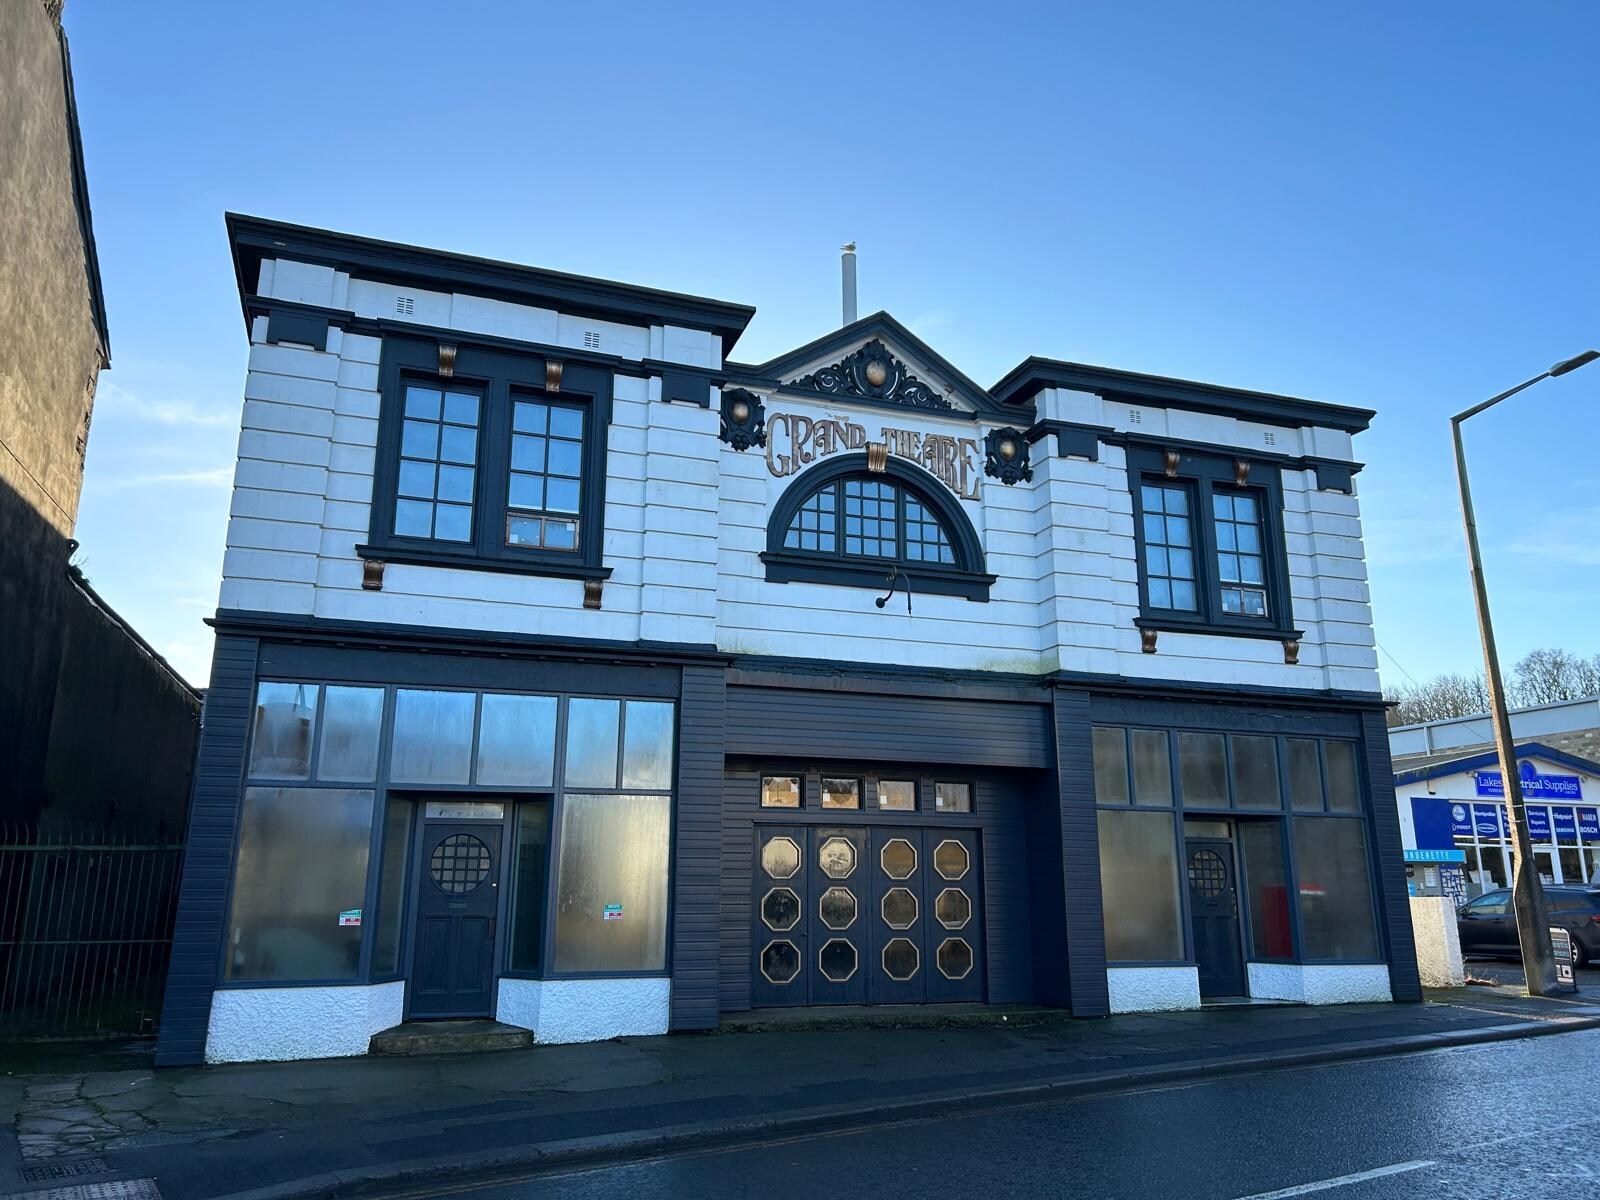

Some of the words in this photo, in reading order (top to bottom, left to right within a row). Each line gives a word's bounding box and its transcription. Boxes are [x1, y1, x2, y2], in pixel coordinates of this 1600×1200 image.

[766, 413, 867, 477] GRAND
[881, 427, 981, 500] THEATRE
[1478, 777, 1503, 788] Lakes
[1520, 779, 1543, 790] trical
[1544, 779, 1578, 793] Supplies
[1404, 851, 1449, 860] UNDERETTE
